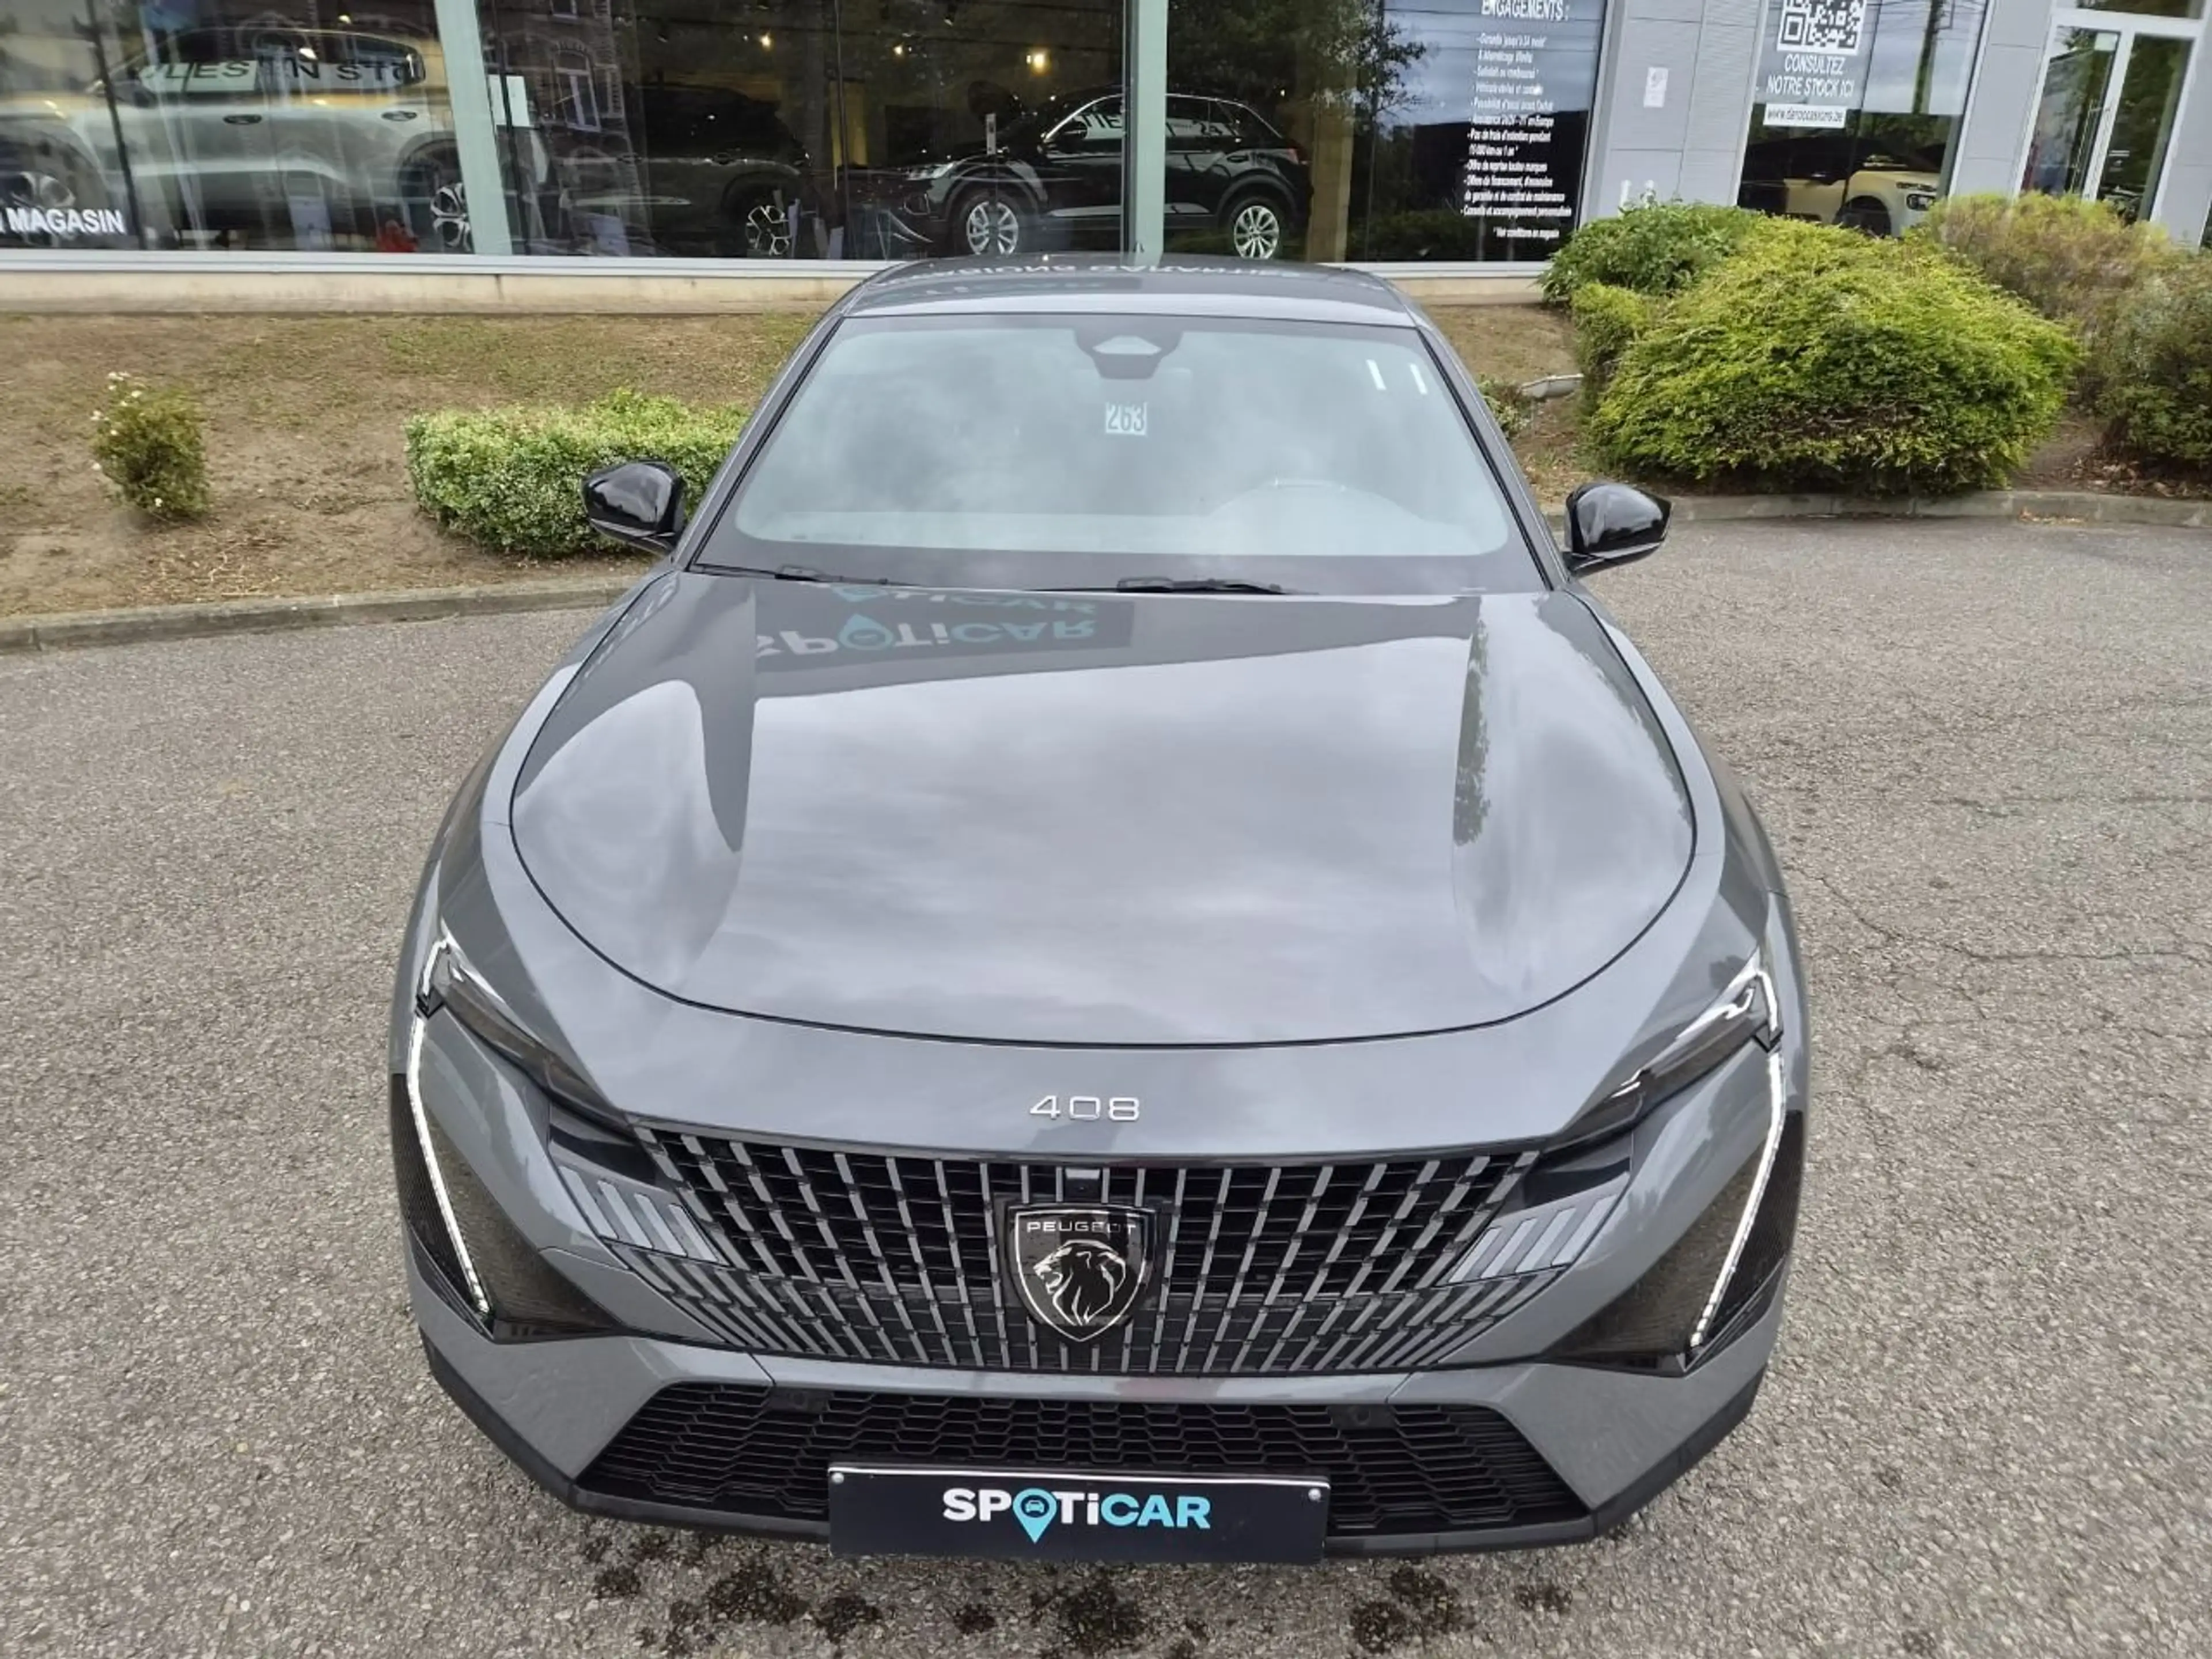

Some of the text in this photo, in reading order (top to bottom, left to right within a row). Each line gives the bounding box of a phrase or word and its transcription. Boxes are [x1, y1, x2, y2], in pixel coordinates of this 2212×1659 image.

[1785, 53, 1846, 75] CONSULTEZ
[1766, 74, 1855, 97] NOTRE STOCK ICI
[6, 207, 127, 235] MAGASIN
[1108, 401, 1145, 431] 263
[1030, 1095, 1140, 1121] 408
[1027, 1221, 1137, 1235] PEUGEOT
